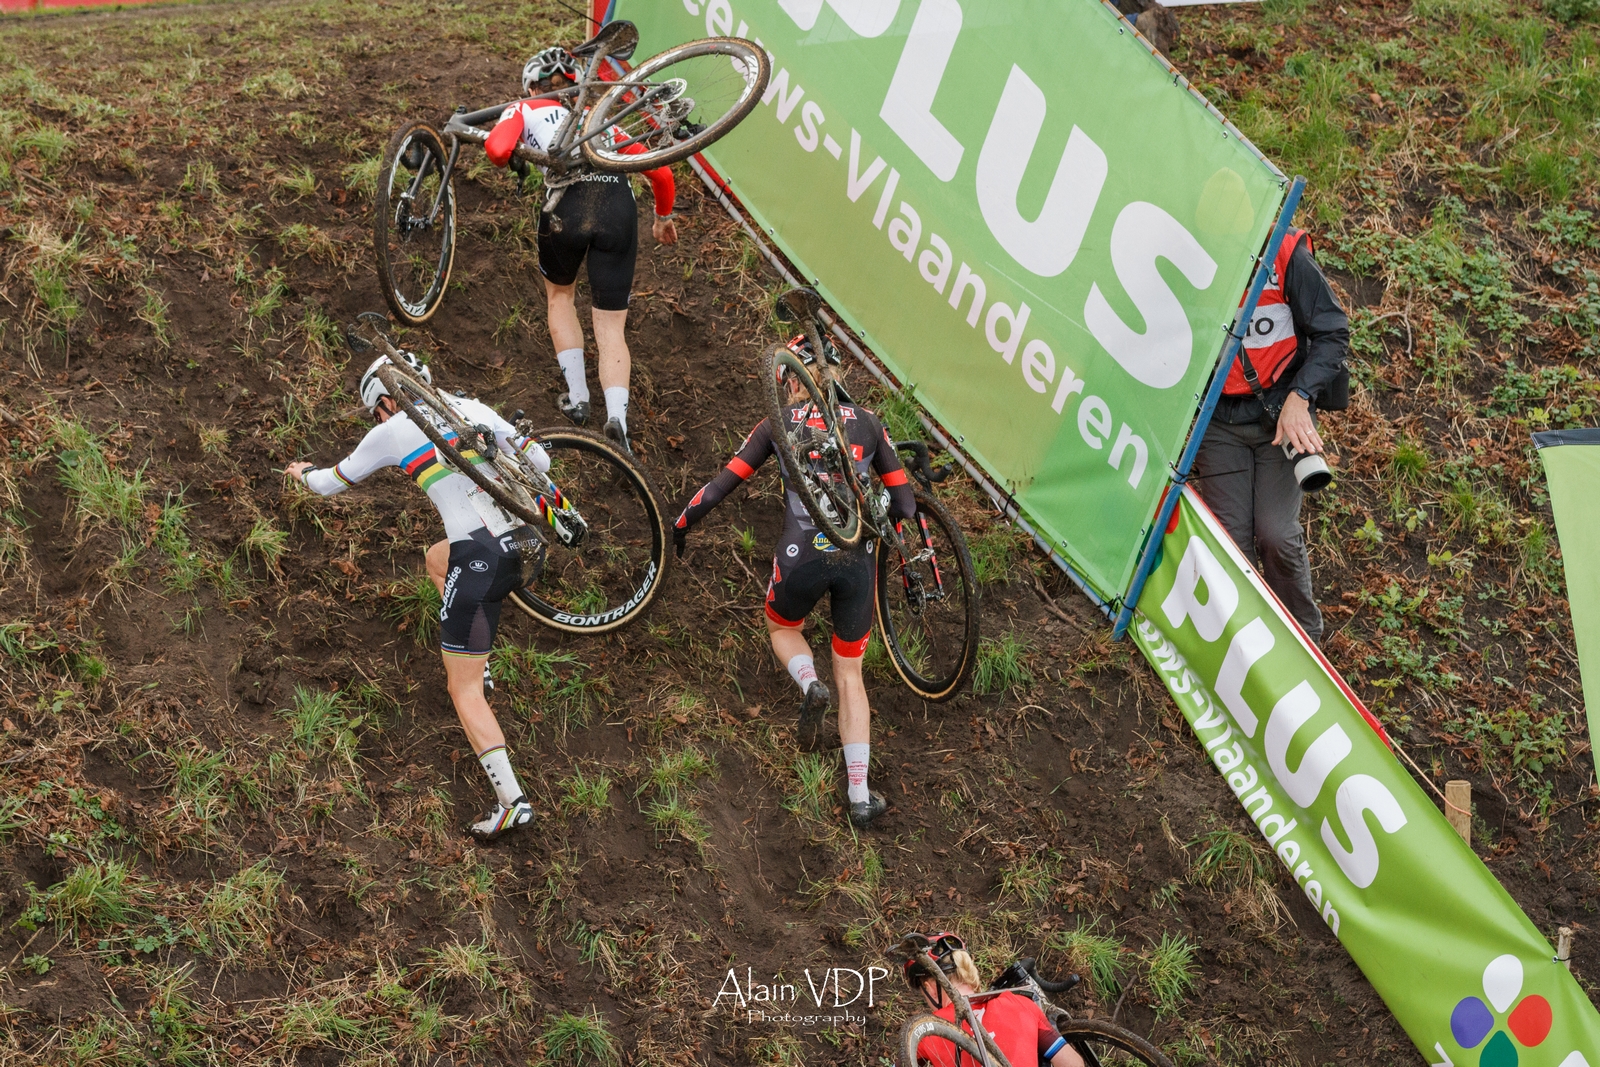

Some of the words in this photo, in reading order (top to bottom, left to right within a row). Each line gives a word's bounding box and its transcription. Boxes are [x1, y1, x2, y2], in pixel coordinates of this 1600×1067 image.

[683, 0, 1149, 489] euws-Vlaanderen
[552, 560, 657, 626] BONTRAGER
[1160, 535, 1408, 888] PLUS
